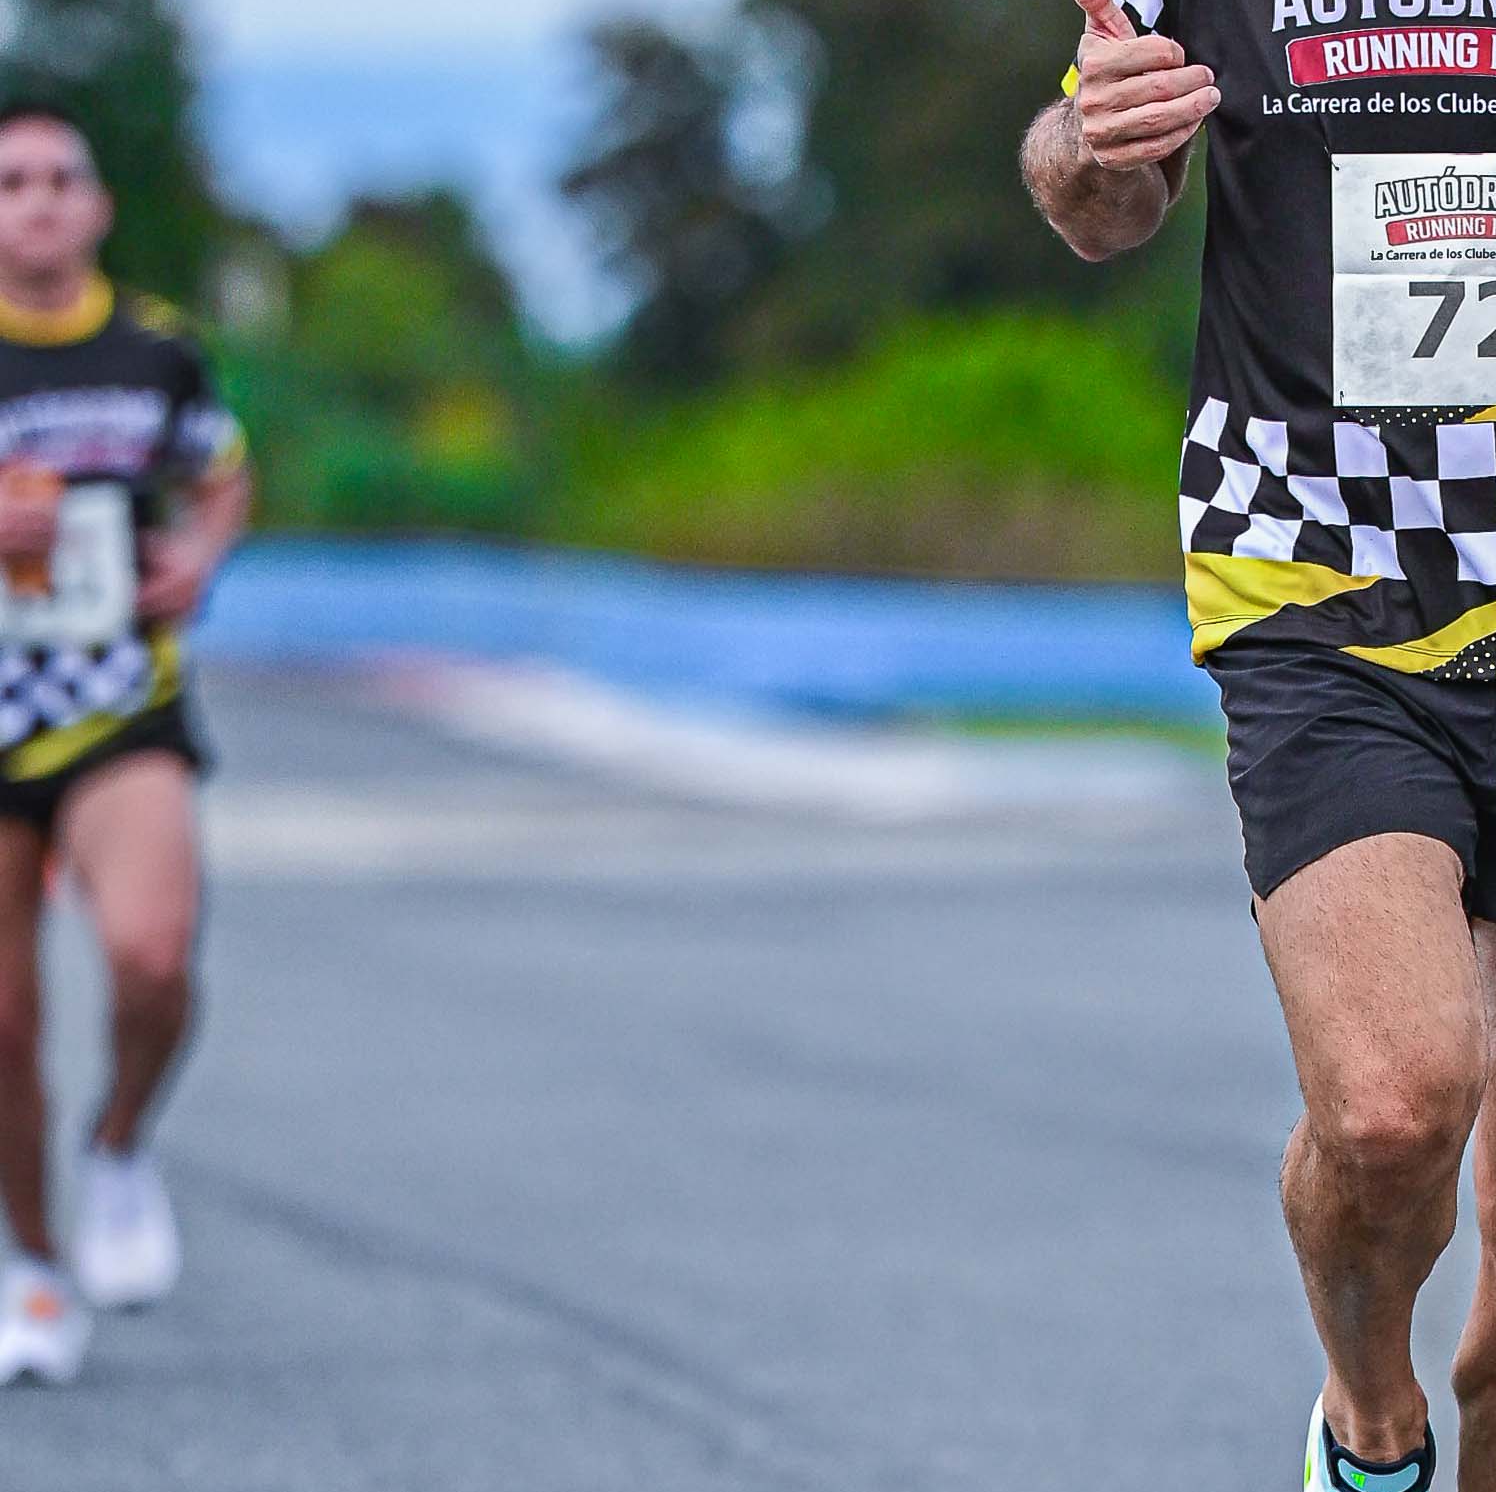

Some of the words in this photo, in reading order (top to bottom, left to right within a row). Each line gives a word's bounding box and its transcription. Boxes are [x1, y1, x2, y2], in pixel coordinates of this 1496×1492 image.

[1322, 31, 1480, 78] RUNNING
[1262, 94, 1284, 115] La
[1287, 93, 1362, 115] Carrera
[1367, 92, 1395, 114] de
[1401, 92, 1432, 114] los
[1405, 216, 1486, 242] RUNNING
[1371, 250, 1384, 261] La
[1386, 249, 1427, 261] Carrera
[1430, 248, 1444, 259] de
[1446, 248, 1463, 259] los
